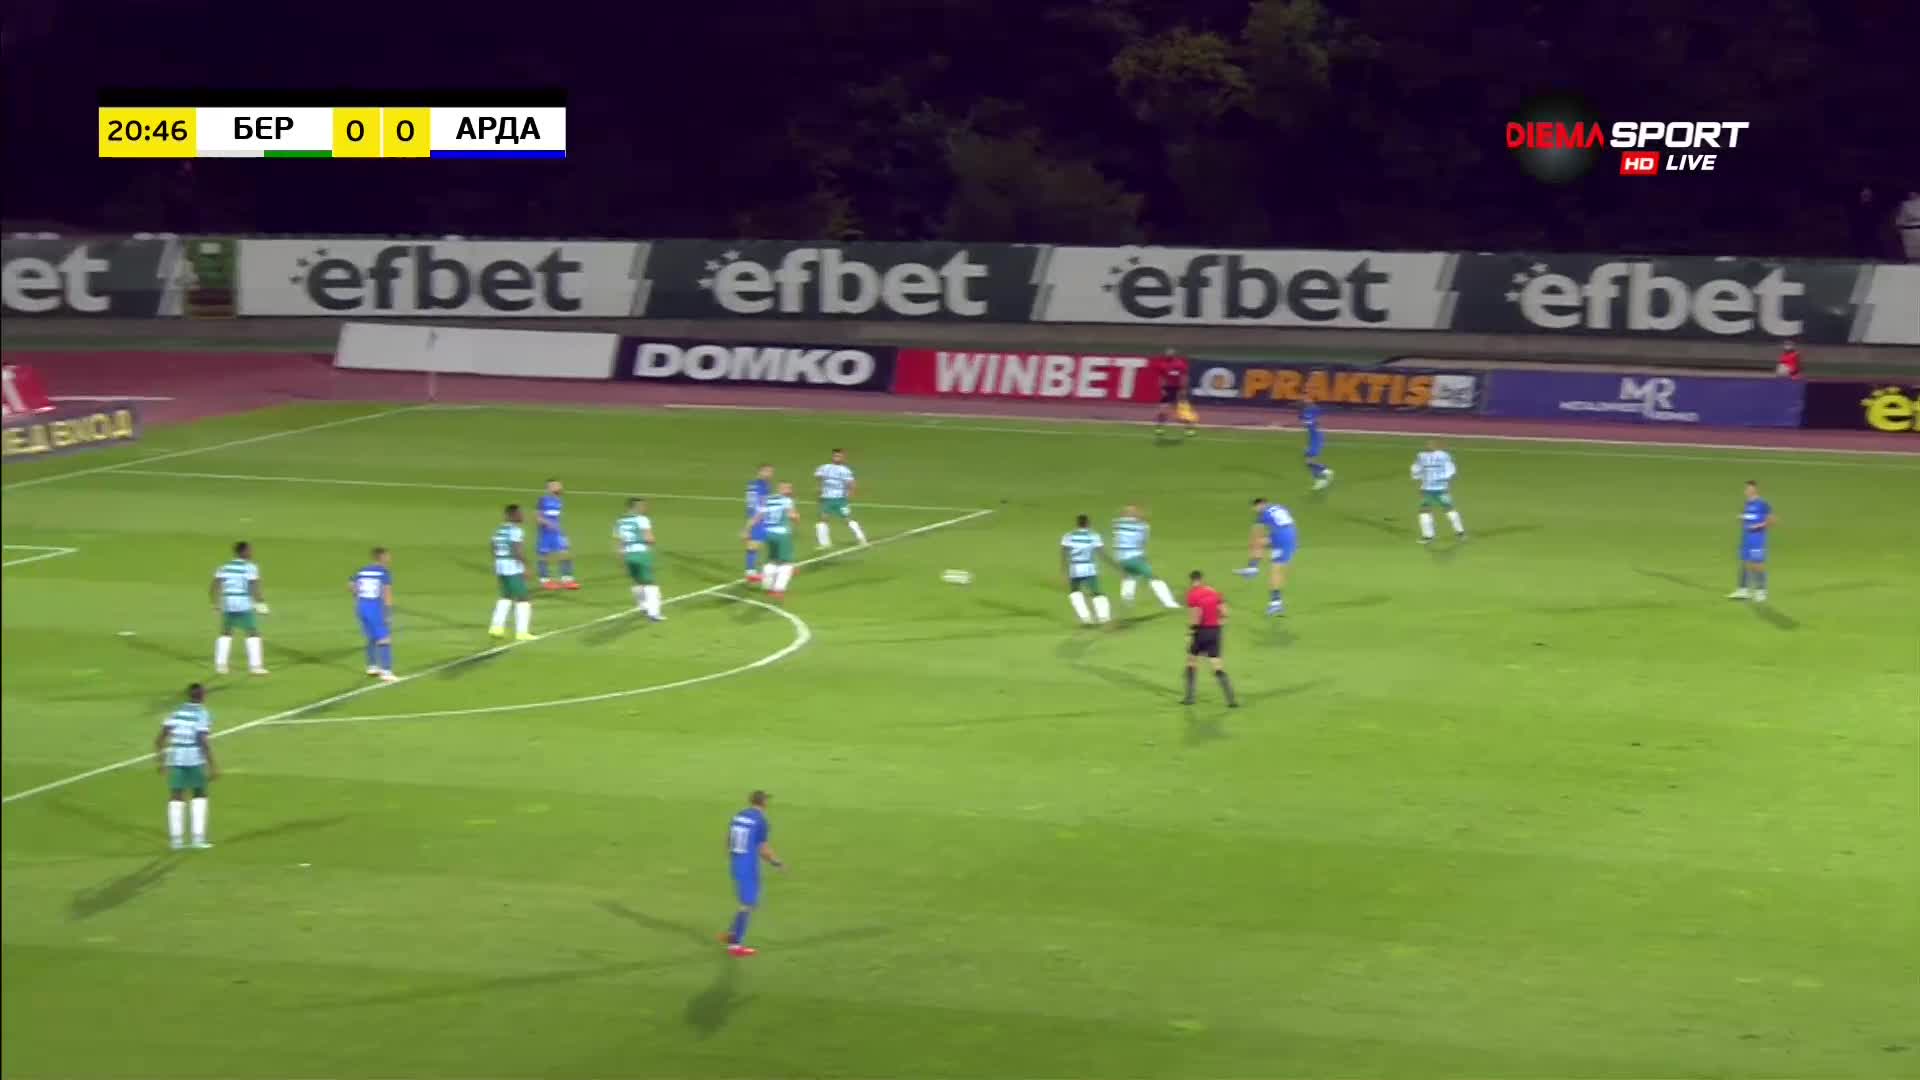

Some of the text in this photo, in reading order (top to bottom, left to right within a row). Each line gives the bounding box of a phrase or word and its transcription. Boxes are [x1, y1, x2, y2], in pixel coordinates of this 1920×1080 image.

[306, 245, 583, 312] efbet
[714, 248, 989, 316] efbet
[1118, 254, 1391, 323] efbet
[1519, 262, 1805, 336] efbet
[633, 343, 876, 386] DOMKO
[935, 351, 1148, 398] WINBET
[1243, 368, 1433, 407] PRAKTIS
